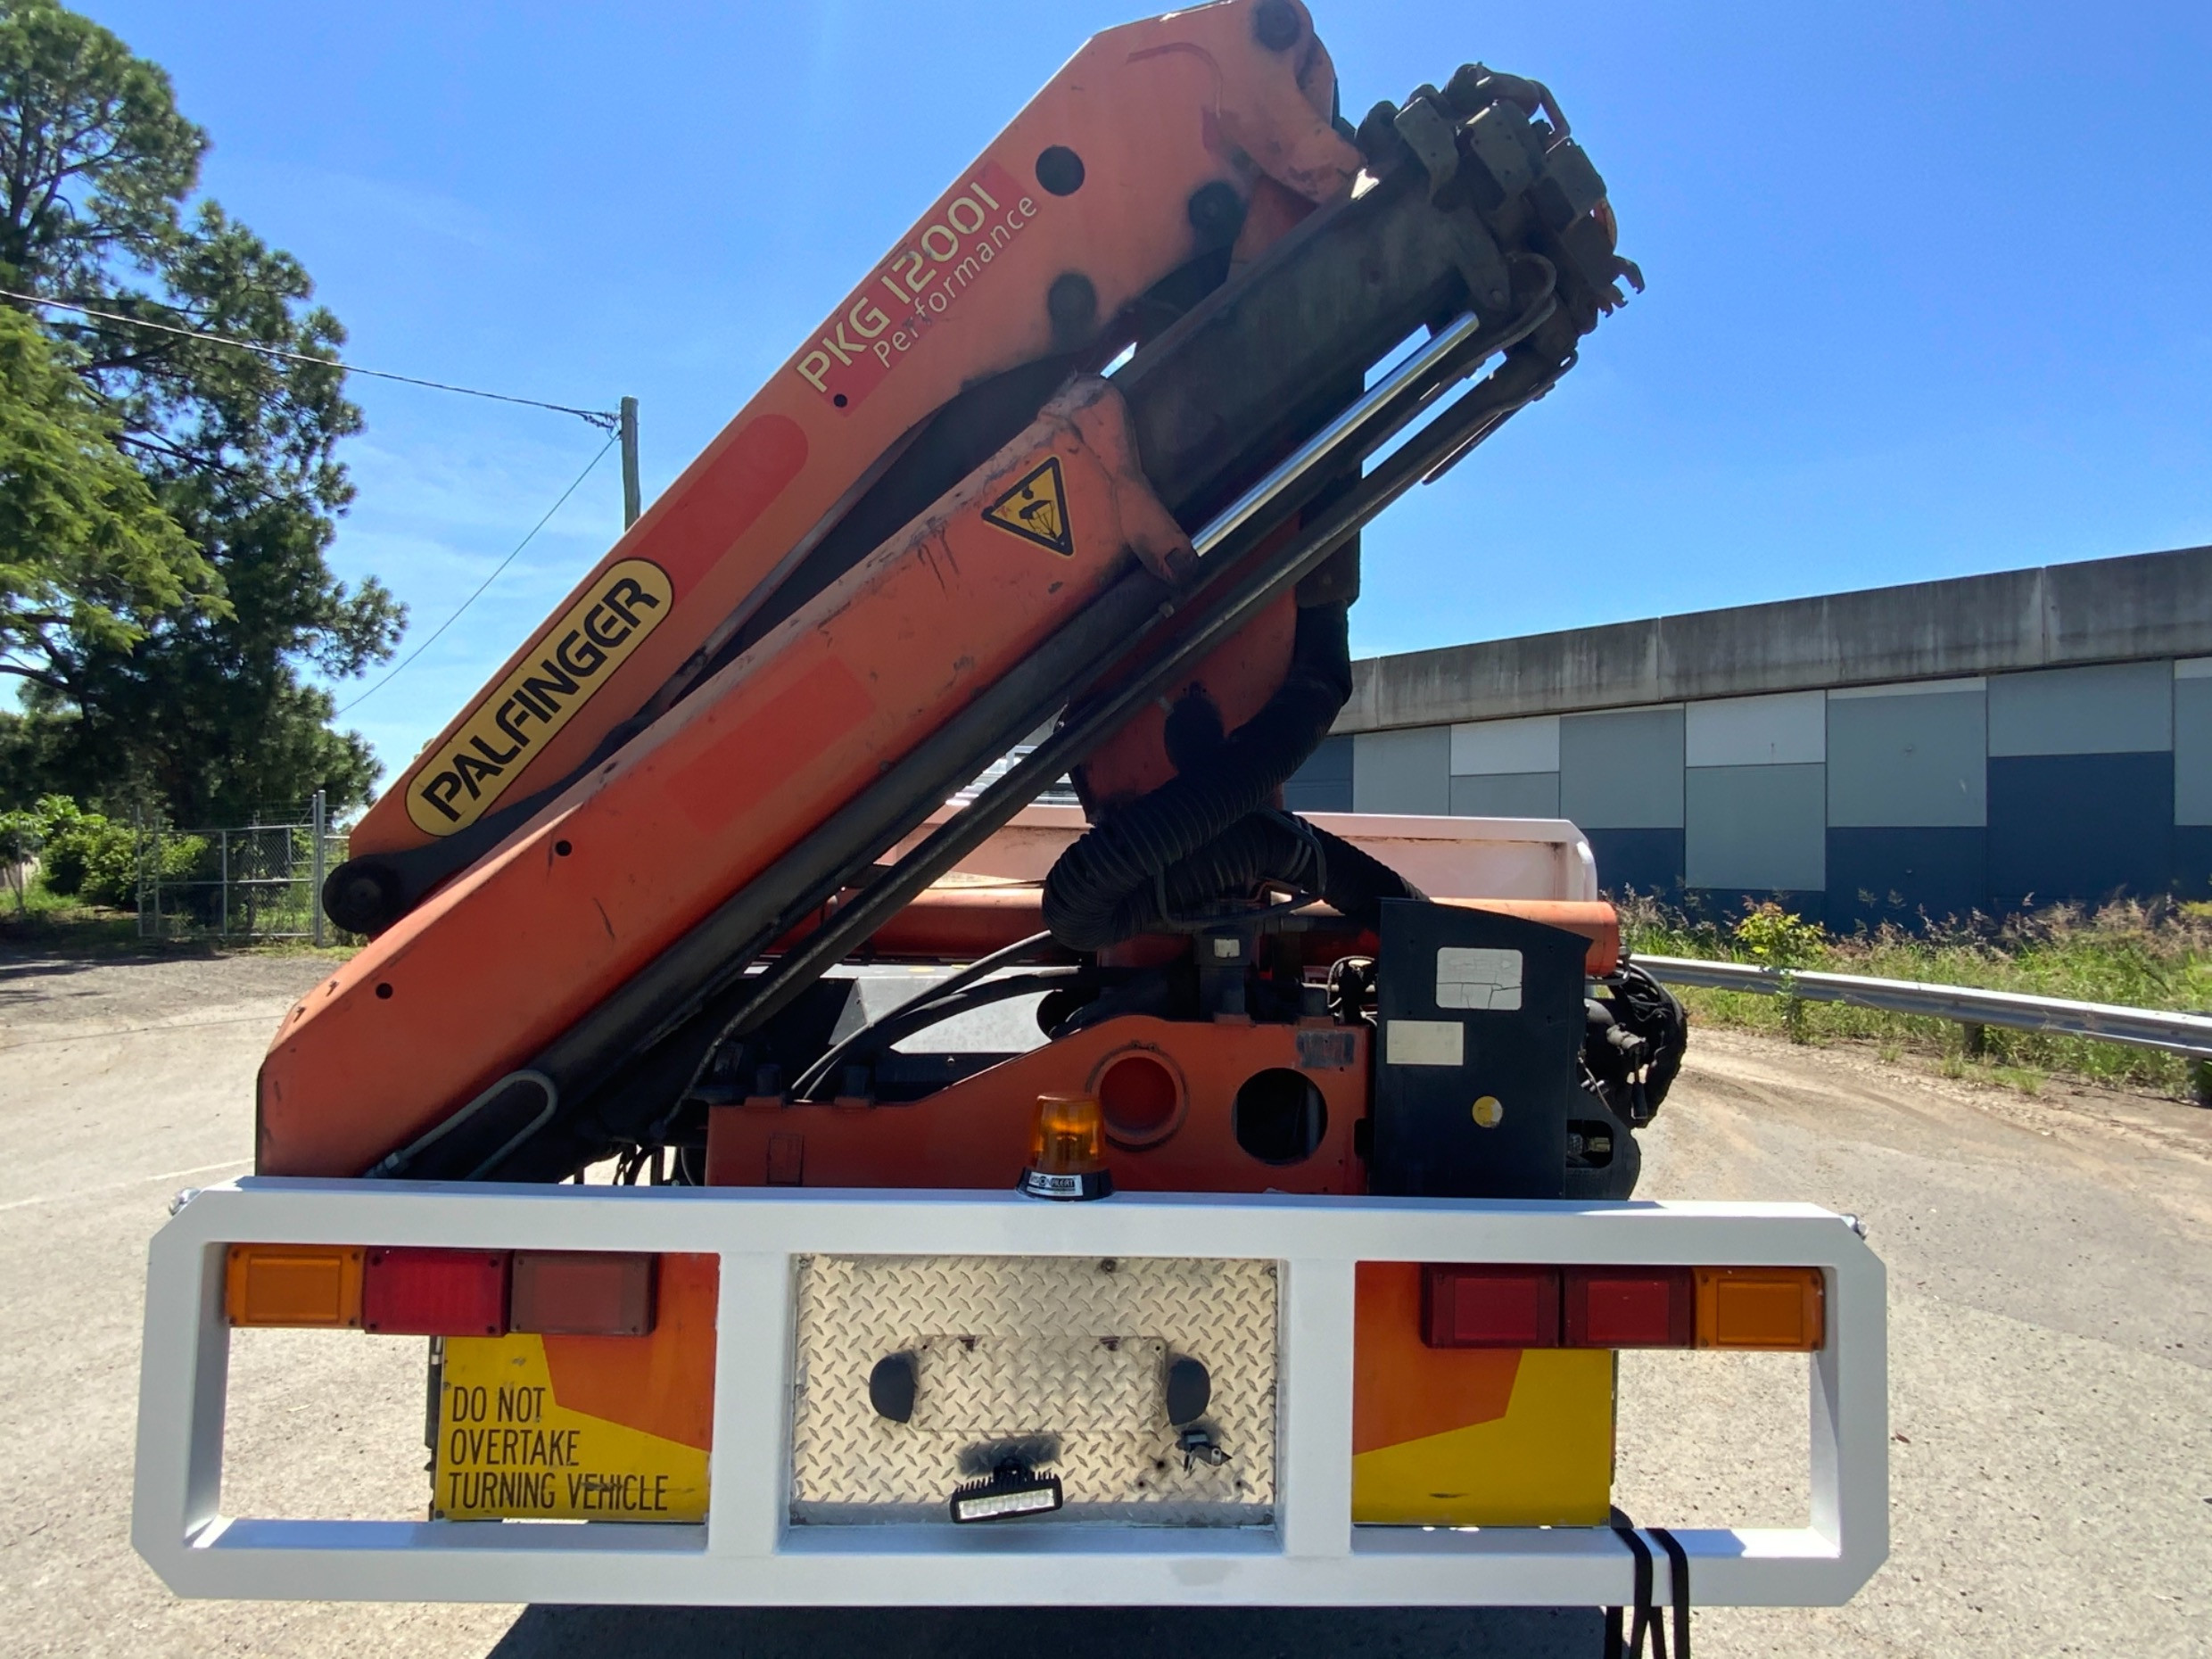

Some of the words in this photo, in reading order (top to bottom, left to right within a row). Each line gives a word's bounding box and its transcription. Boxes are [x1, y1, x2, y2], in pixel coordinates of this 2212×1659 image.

[796, 297, 890, 392] PKG
[881, 182, 999, 304] 12001
[873, 197, 1036, 368] Performance
[421, 578, 659, 821] PALFINGER
[450, 1429, 580, 1465] OVERTAKE
[452, 1386, 487, 1423] DO
[497, 1387, 546, 1424] NOT
[449, 1473, 557, 1509] TURNING
[567, 1473, 669, 1511] VEHICLE
